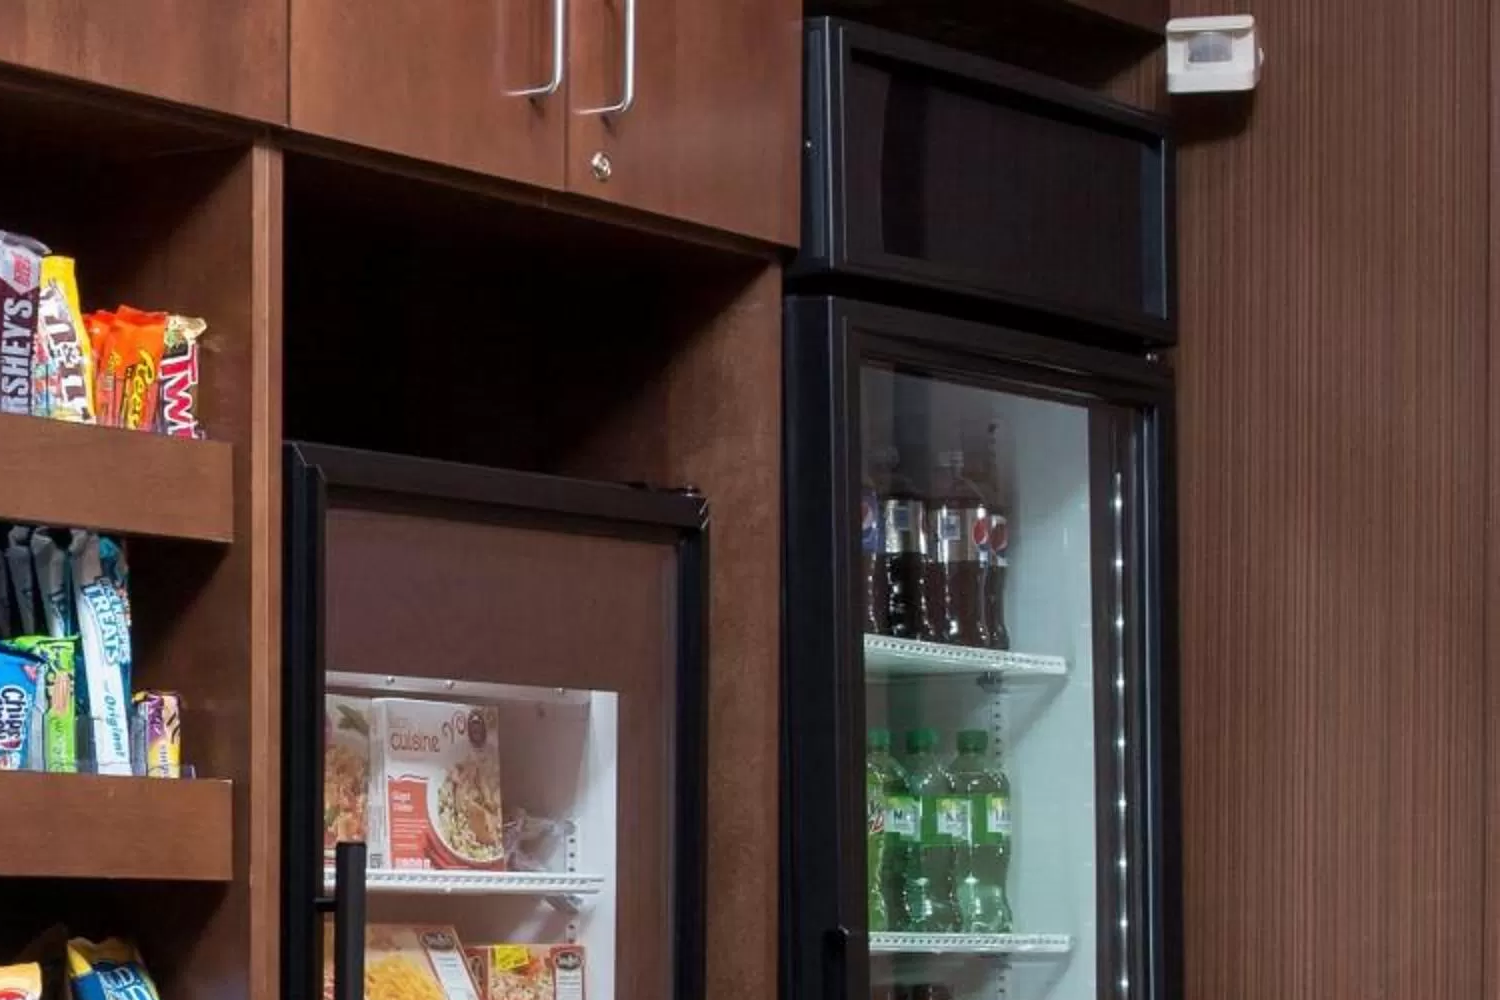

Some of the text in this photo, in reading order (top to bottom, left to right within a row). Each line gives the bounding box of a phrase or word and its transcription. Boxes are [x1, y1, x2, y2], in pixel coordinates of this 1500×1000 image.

[81, 581, 121, 667] TREATS
[2, 687, 27, 737] Chips
[104, 696, 126, 757] Original
[390, 730, 441, 753] cuisine
